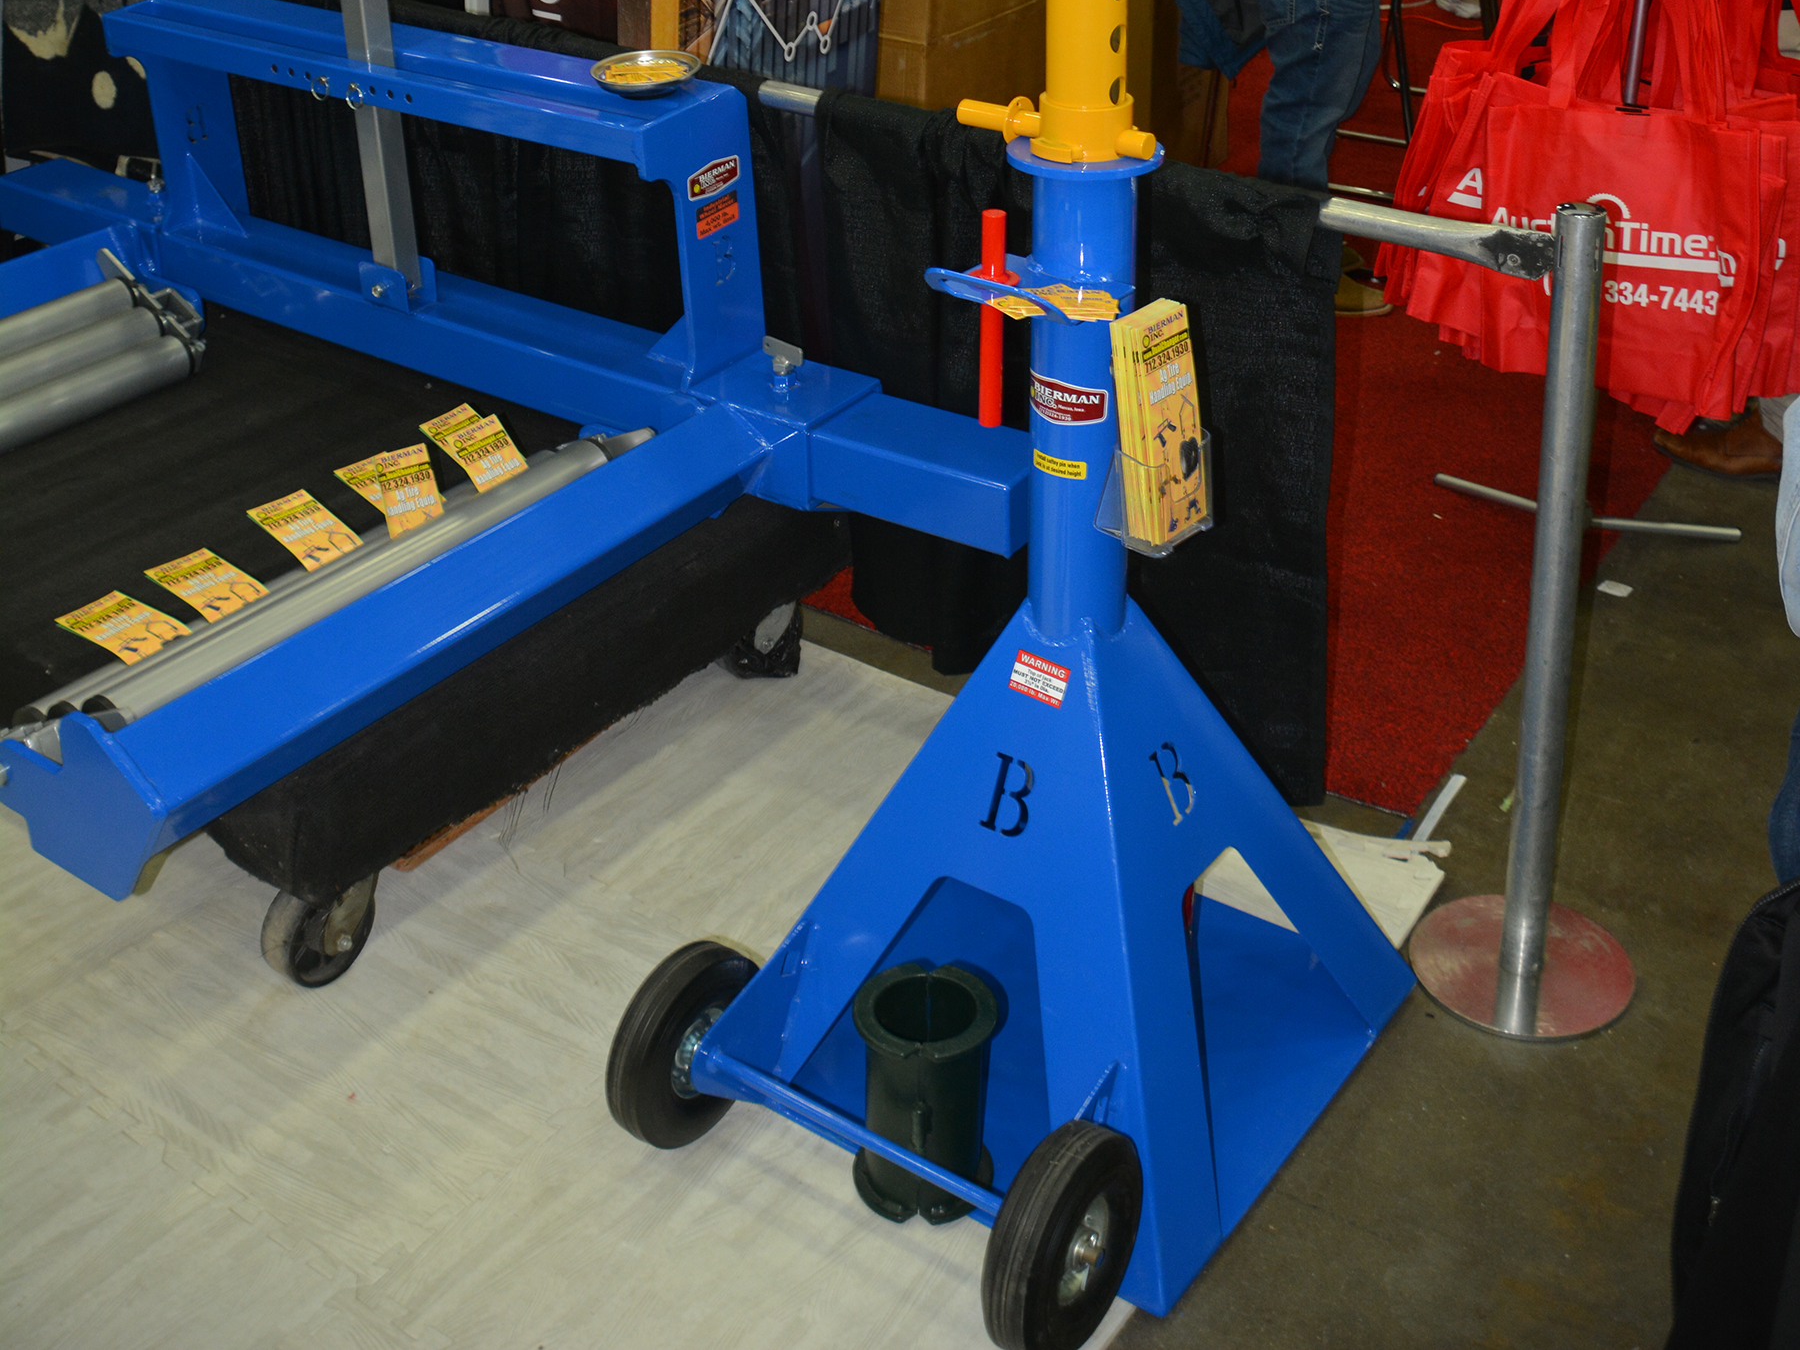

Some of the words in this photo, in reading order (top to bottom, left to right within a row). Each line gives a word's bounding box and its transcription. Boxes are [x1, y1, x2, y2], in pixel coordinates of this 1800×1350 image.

[699, 159, 737, 183] BIERMAN
[1604, 279, 1719, 316] 334-7443
[1148, 310, 1184, 334] BIERMAN
[1144, 341, 1189, 374] 712.324.1930
[1167, 362, 1179, 379] Tire
[1034, 381, 1101, 405] BIERMAN
[1035, 391, 1057, 409] INC.
[1149, 381, 1177, 406] Handling
[431, 407, 467, 426] BIERMAN
[457, 418, 496, 439] BIERMAN
[381, 446, 424, 463] BIERMAN
[461, 437, 509, 465] 712.324.1930
[1021, 653, 1067, 679] WARNING
[1013, 668, 1029, 679] MUST
[1029, 676, 1041, 684] NOT
[1042, 681, 1064, 694] EXCEED
[980, 751, 1035, 837] B
[1149, 741, 1196, 826] B
